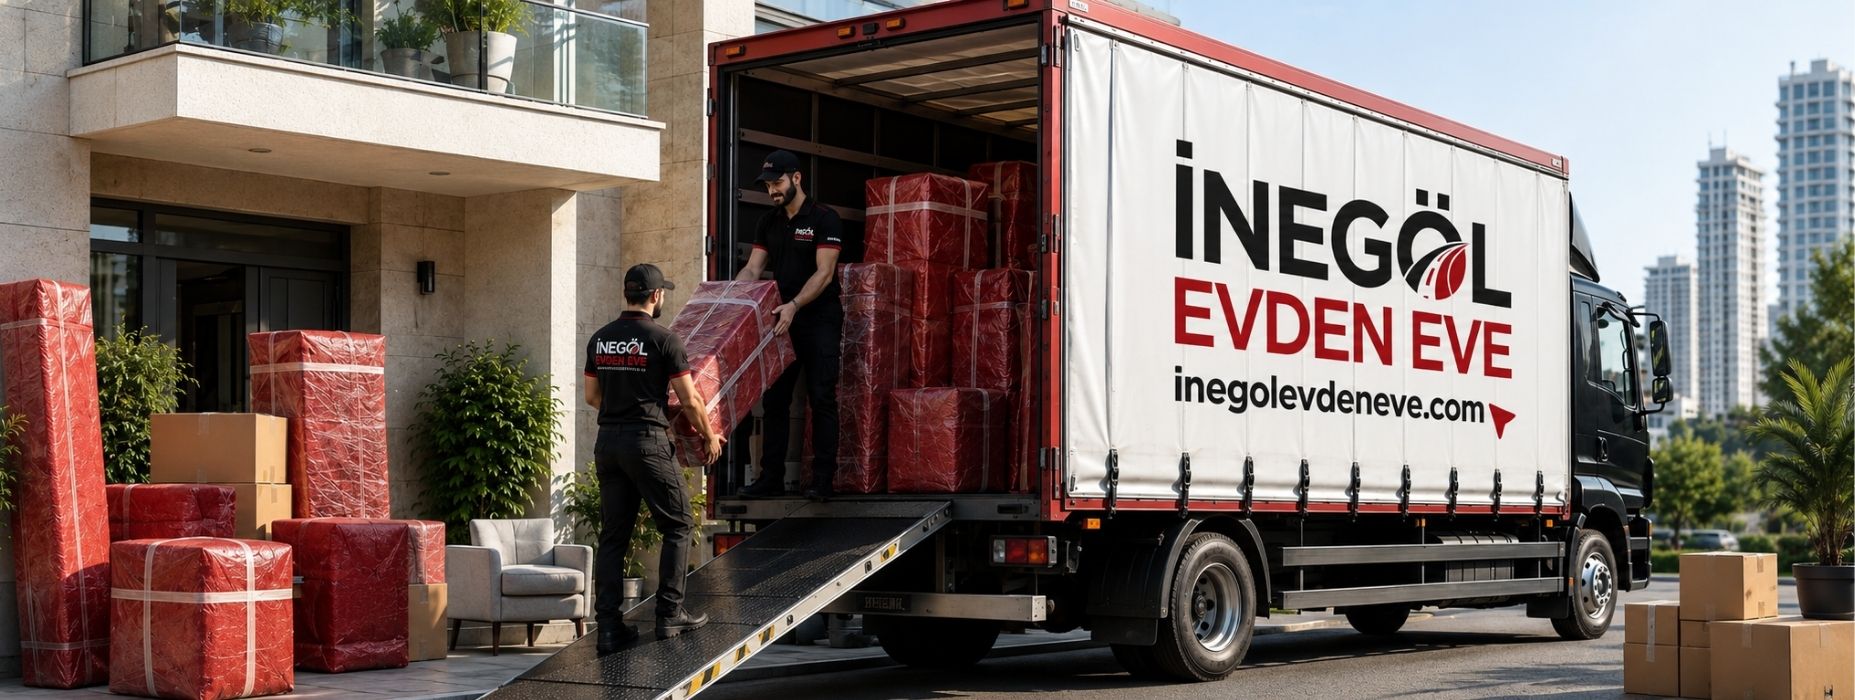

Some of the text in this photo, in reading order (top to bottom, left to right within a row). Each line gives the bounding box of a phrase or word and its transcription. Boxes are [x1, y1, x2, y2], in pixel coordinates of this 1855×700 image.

[1175, 139, 1512, 308] İNEGÖL
[596, 338, 648, 356] İNEGÖL
[1174, 277, 1512, 379] EVDEN EVE
[628, 357, 648, 366] EVE
[1174, 365, 1485, 423] inegolevdeneve.com
